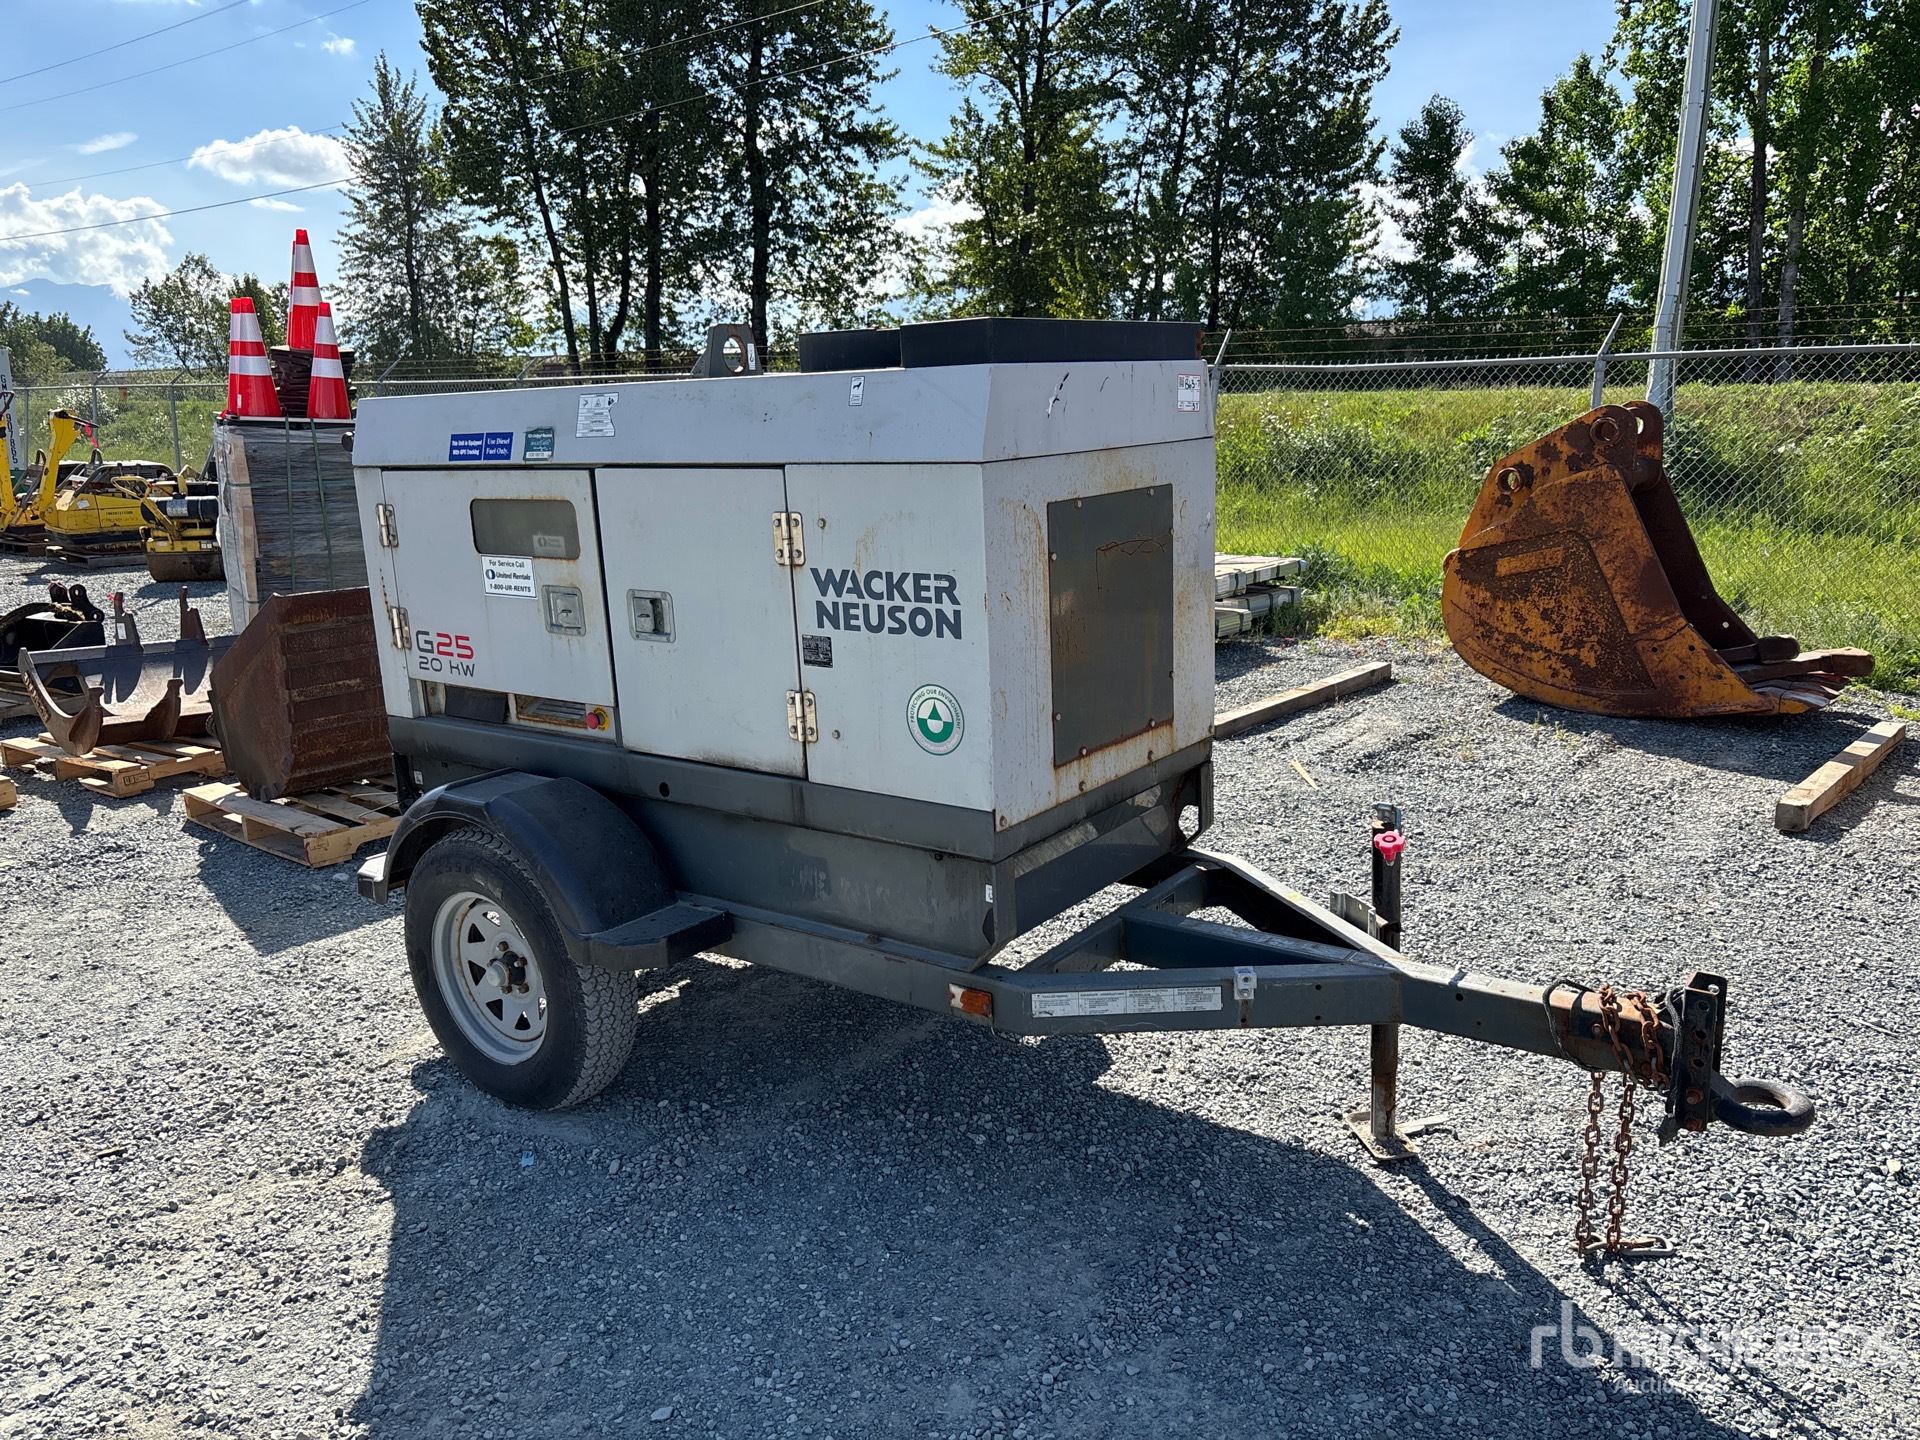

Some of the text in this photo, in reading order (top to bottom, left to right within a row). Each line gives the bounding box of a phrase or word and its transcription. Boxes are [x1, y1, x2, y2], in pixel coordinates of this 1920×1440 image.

[6, 413, 18, 464] 907865
[495, 572, 512, 580] United
[498, 560, 515, 568] Service
[489, 584, 531, 593] 1-800-UR-RENTS
[810, 567, 961, 606] WACKER
[816, 600, 962, 640] NEUSON
[415, 630, 474, 660] G25
[419, 655, 443, 672] 20
[910, 690, 926, 723] PROTECTING
[937, 690, 961, 730] ENVIRONMENT
